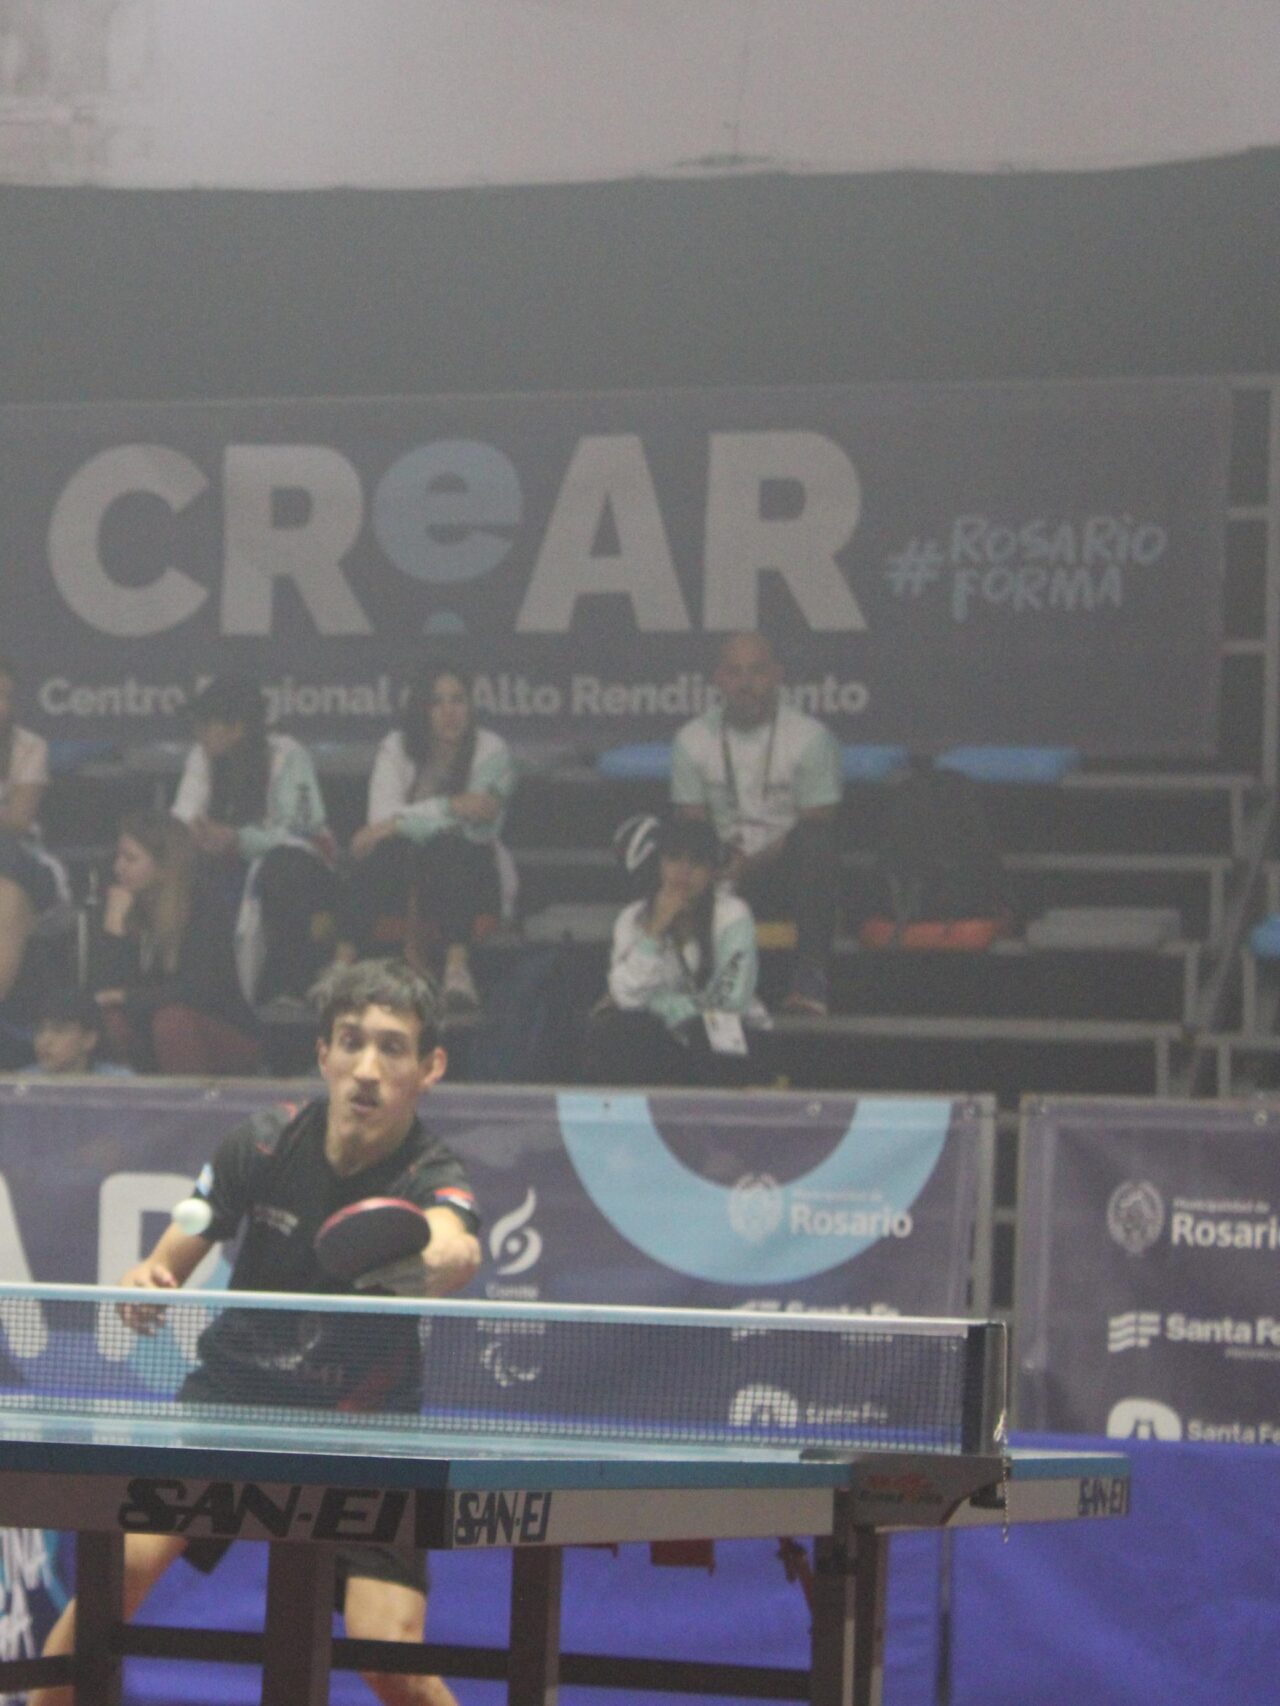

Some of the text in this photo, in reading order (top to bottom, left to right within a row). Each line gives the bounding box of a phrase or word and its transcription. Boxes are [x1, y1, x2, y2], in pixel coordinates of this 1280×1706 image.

[38, 676, 187, 716] Centro
[472, 674, 561, 716] Alto
[789, 1201, 914, 1239] Rosario
[1170, 1211, 1280, 1250] Rosari
[1166, 1312, 1253, 1345] Santa
[1187, 1409, 1256, 1443] Santa
[119, 1477, 410, 1543] SAN-EI
[453, 1490, 552, 1545] SAN-EI
